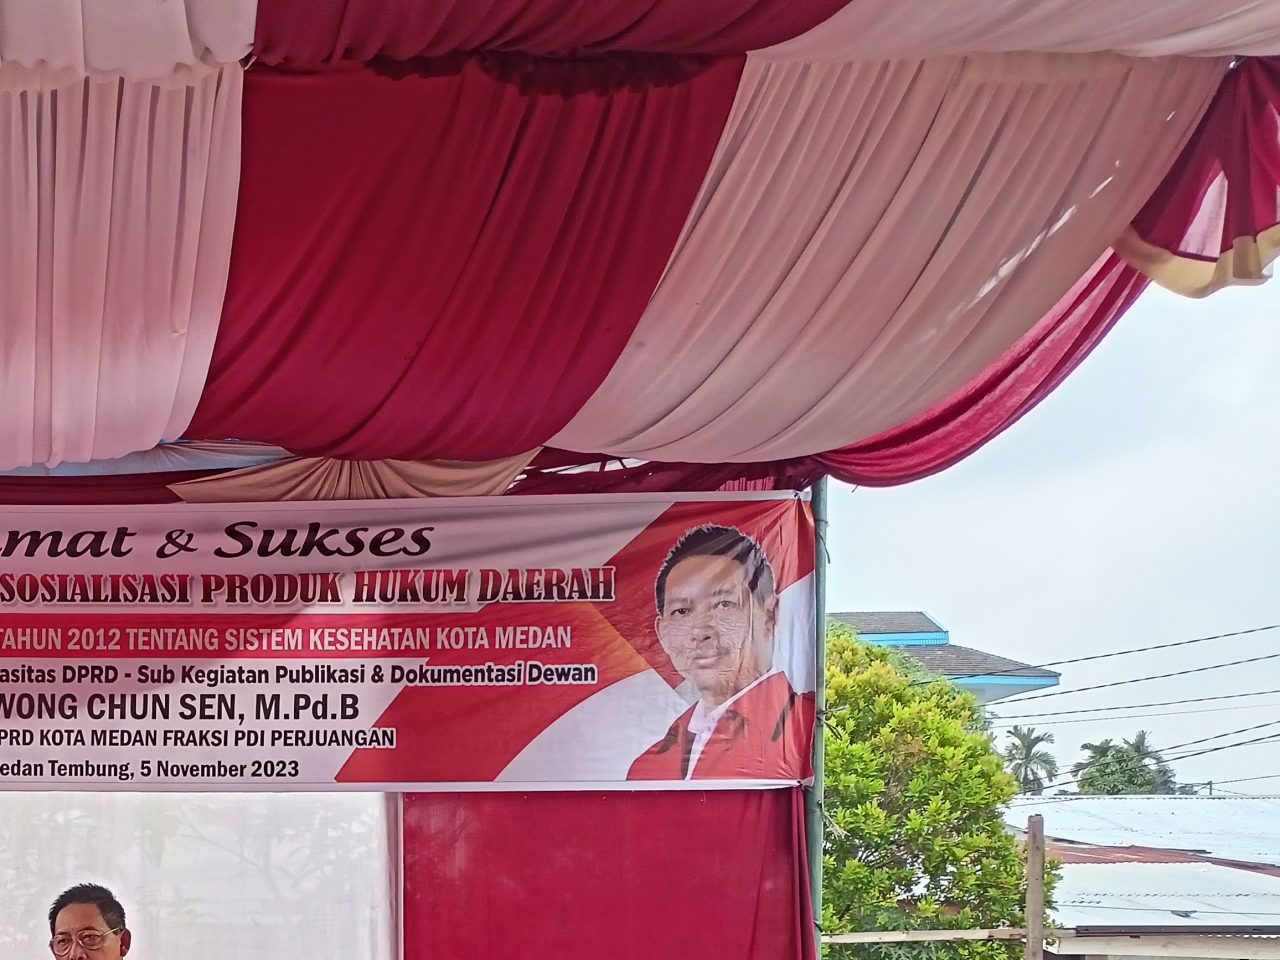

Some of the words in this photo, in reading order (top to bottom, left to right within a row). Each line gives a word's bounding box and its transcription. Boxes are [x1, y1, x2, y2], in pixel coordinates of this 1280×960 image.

[155, 528, 199, 559] &
[213, 520, 435, 559] Sukses
[200, 571, 342, 604] PRODUK
[352, 568, 469, 604] HUKUM
[475, 567, 616, 602] DAERAH
[67, 628, 121, 651] 2012
[125, 628, 219, 651] TENTANG
[224, 627, 303, 651] SISTEM
[309, 626, 430, 651] KESEHATAN
[436, 626, 490, 650] KOTA
[495, 625, 572, 650] MEDAN
[62, 664, 119, 684] DPRD
[136, 664, 175, 685] Sub
[181, 663, 269, 687] Kegiatan
[275, 663, 365, 684] Publikasi
[370, 663, 384, 684] &
[390, 663, 523, 685] Dokumentasi
[527, 663, 597, 683] Dewan
[86, 693, 170, 720] CHUN
[178, 693, 246, 726] SEN,
[255, 693, 360, 720] M.Pd.B
[39, 729, 86, 747] KOTA
[90, 729, 157, 747] MEDAN
[162, 729, 228, 747] FRAKSI
[233, 729, 265, 747] PDI
[270, 729, 395, 748] PERJUANGAN
[47, 759, 135, 781] Tembung,
[140, 760, 152, 778] 5
[156, 760, 247, 778] November
[250, 760, 300, 778] 2023
